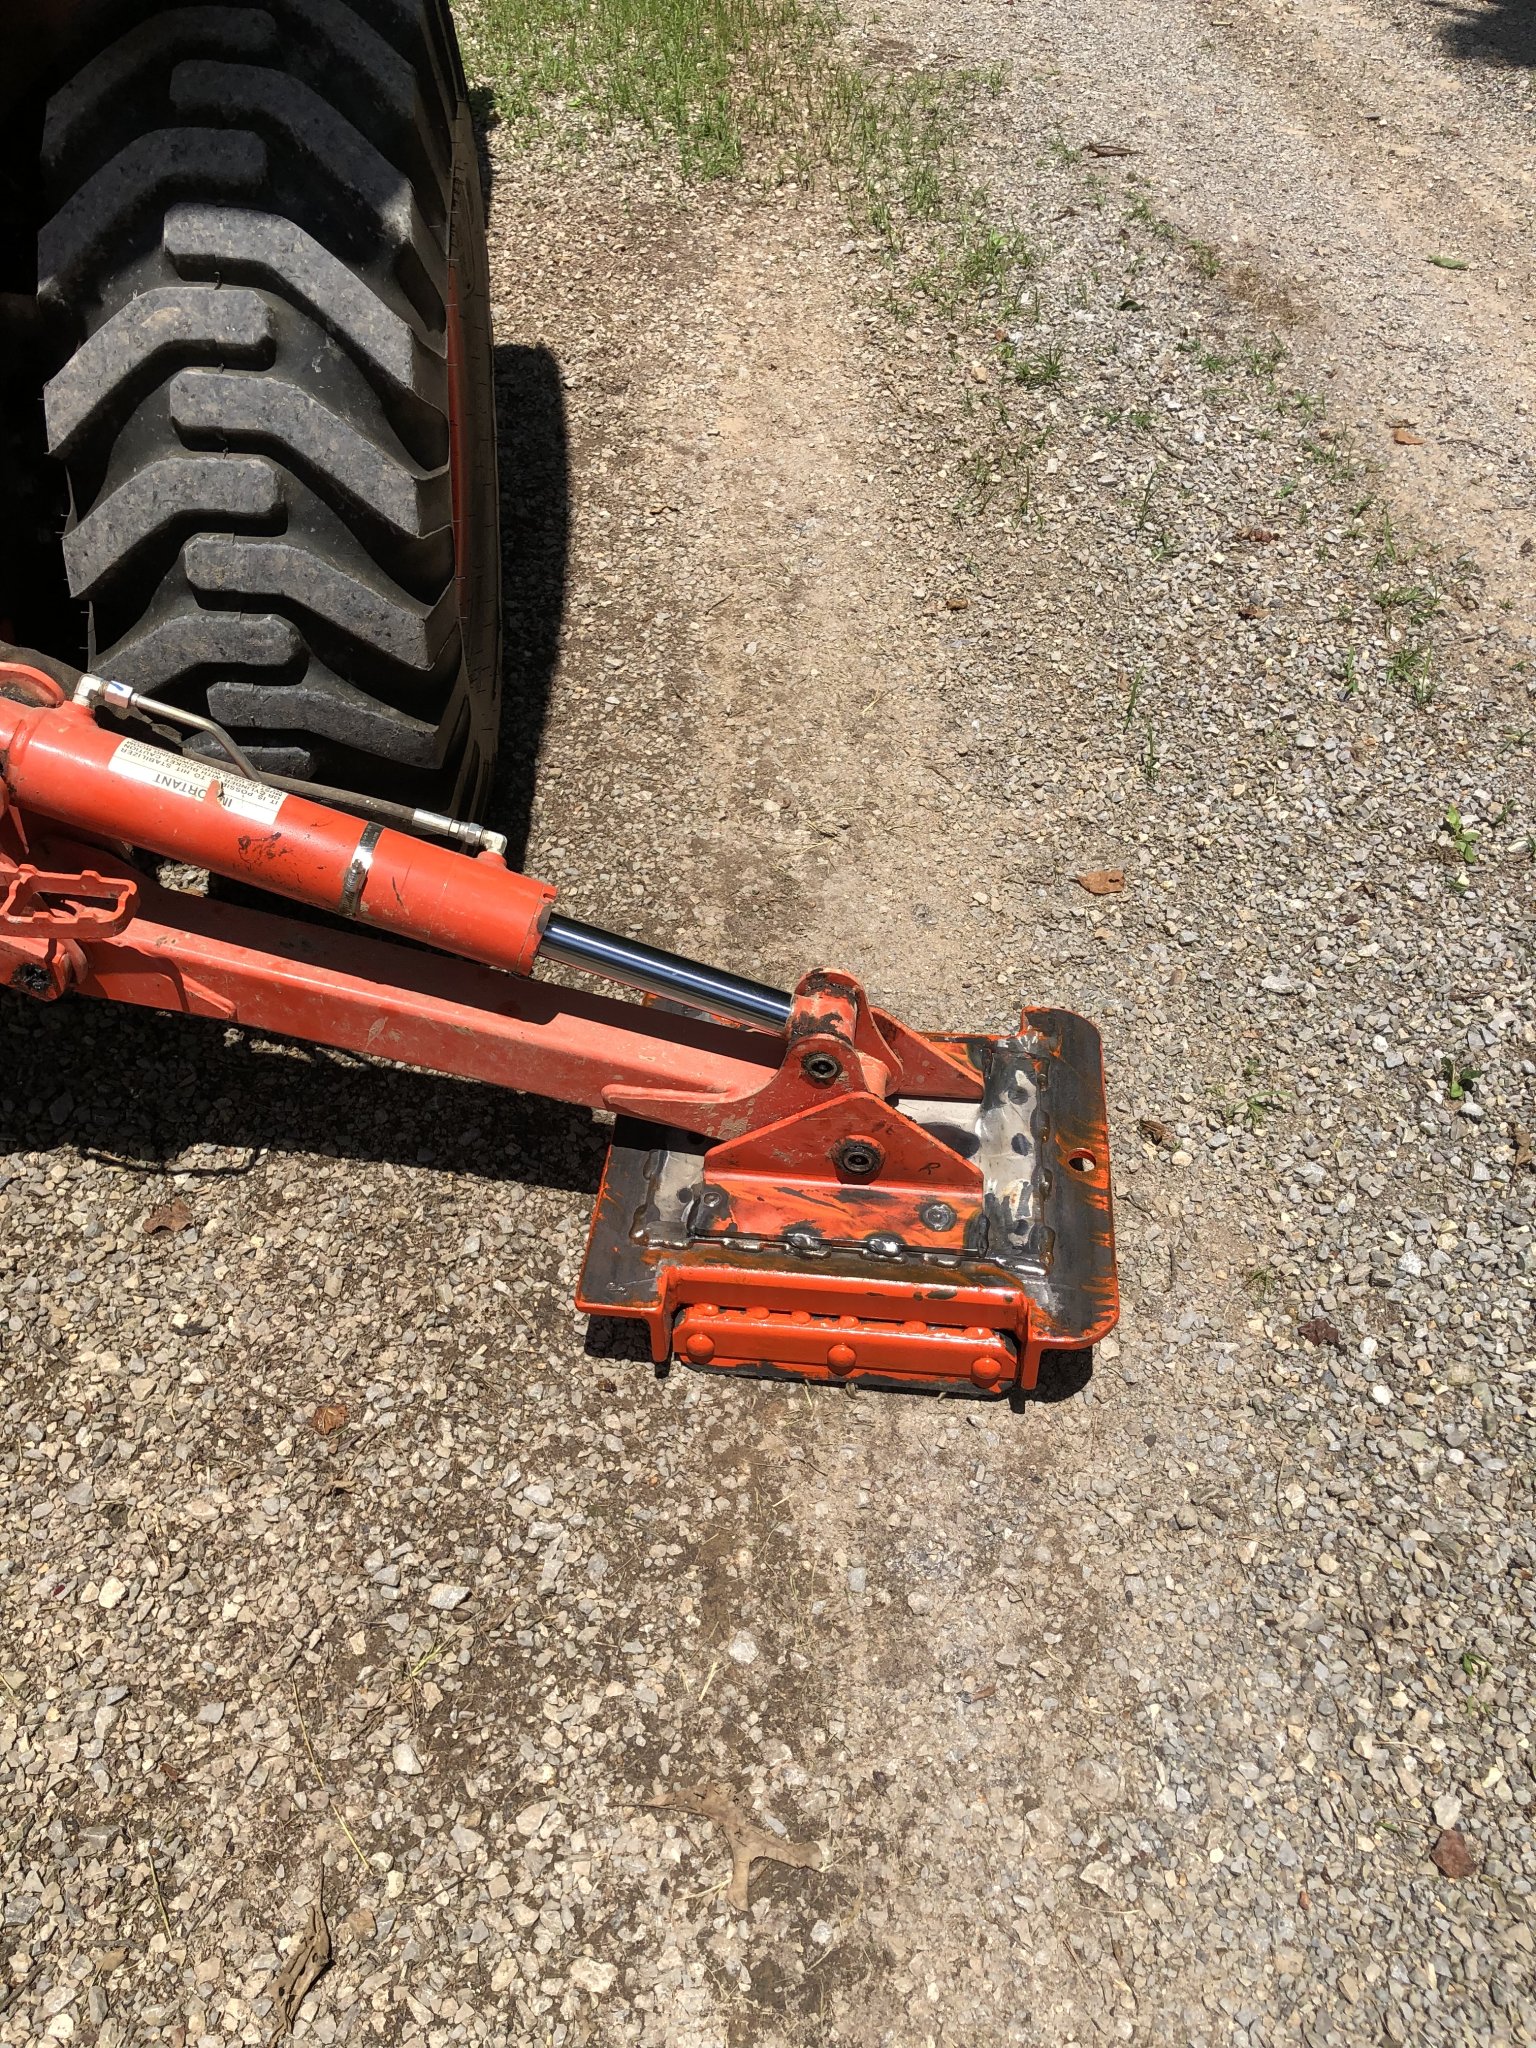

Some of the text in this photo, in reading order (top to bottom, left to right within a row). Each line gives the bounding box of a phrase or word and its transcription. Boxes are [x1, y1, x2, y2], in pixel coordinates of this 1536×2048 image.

[120, 747, 171, 768] STABILIZER
[123, 743, 161, 759] CAUTION
[165, 758, 198, 772] BUCKET
[175, 766, 189, 774] HIT
[193, 772, 205, 780] TO
